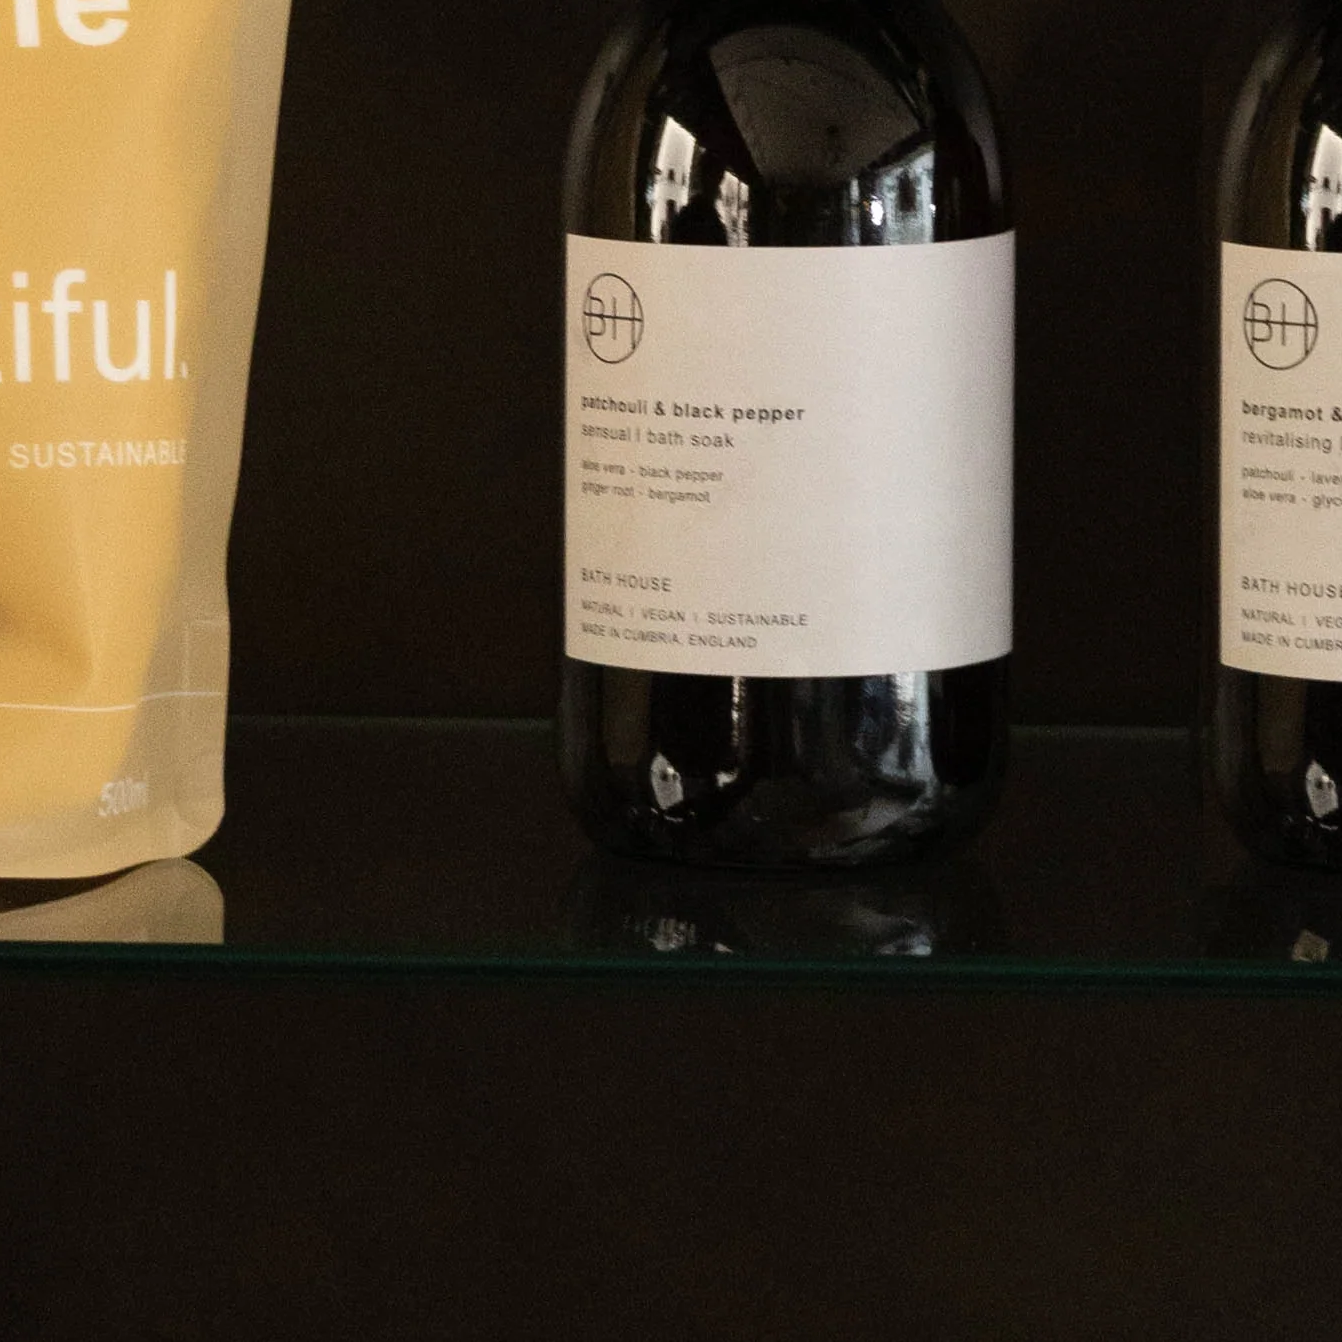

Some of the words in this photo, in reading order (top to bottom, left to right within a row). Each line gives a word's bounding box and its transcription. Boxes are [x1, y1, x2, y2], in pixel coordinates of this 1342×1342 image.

[581, 394, 648, 415] patchouli
[654, 400, 666, 416] &
[673, 403, 724, 419] black
[732, 407, 806, 424] pepper
[1242, 398, 1323, 421] bergamot
[581, 422, 631, 441] sensual
[647, 428, 684, 445] bath
[691, 431, 735, 448] soak
[1242, 429, 1333, 454] revitalising
[9, 438, 187, 470] SUSTAINABLE
[1269, 492, 1296, 504] vera
[581, 568, 611, 584] BATH
[617, 573, 672, 592] HOUSE
[1241, 576, 1280, 594] BATH
[642, 609, 685, 623] VEGAN
[708, 611, 809, 627] SUSTAINABLE
[1241, 607, 1295, 626] NATURAL
[689, 633, 758, 649] ENGLAND
[1241, 630, 1275, 647] MADE
[1278, 635, 1290, 648] IN
